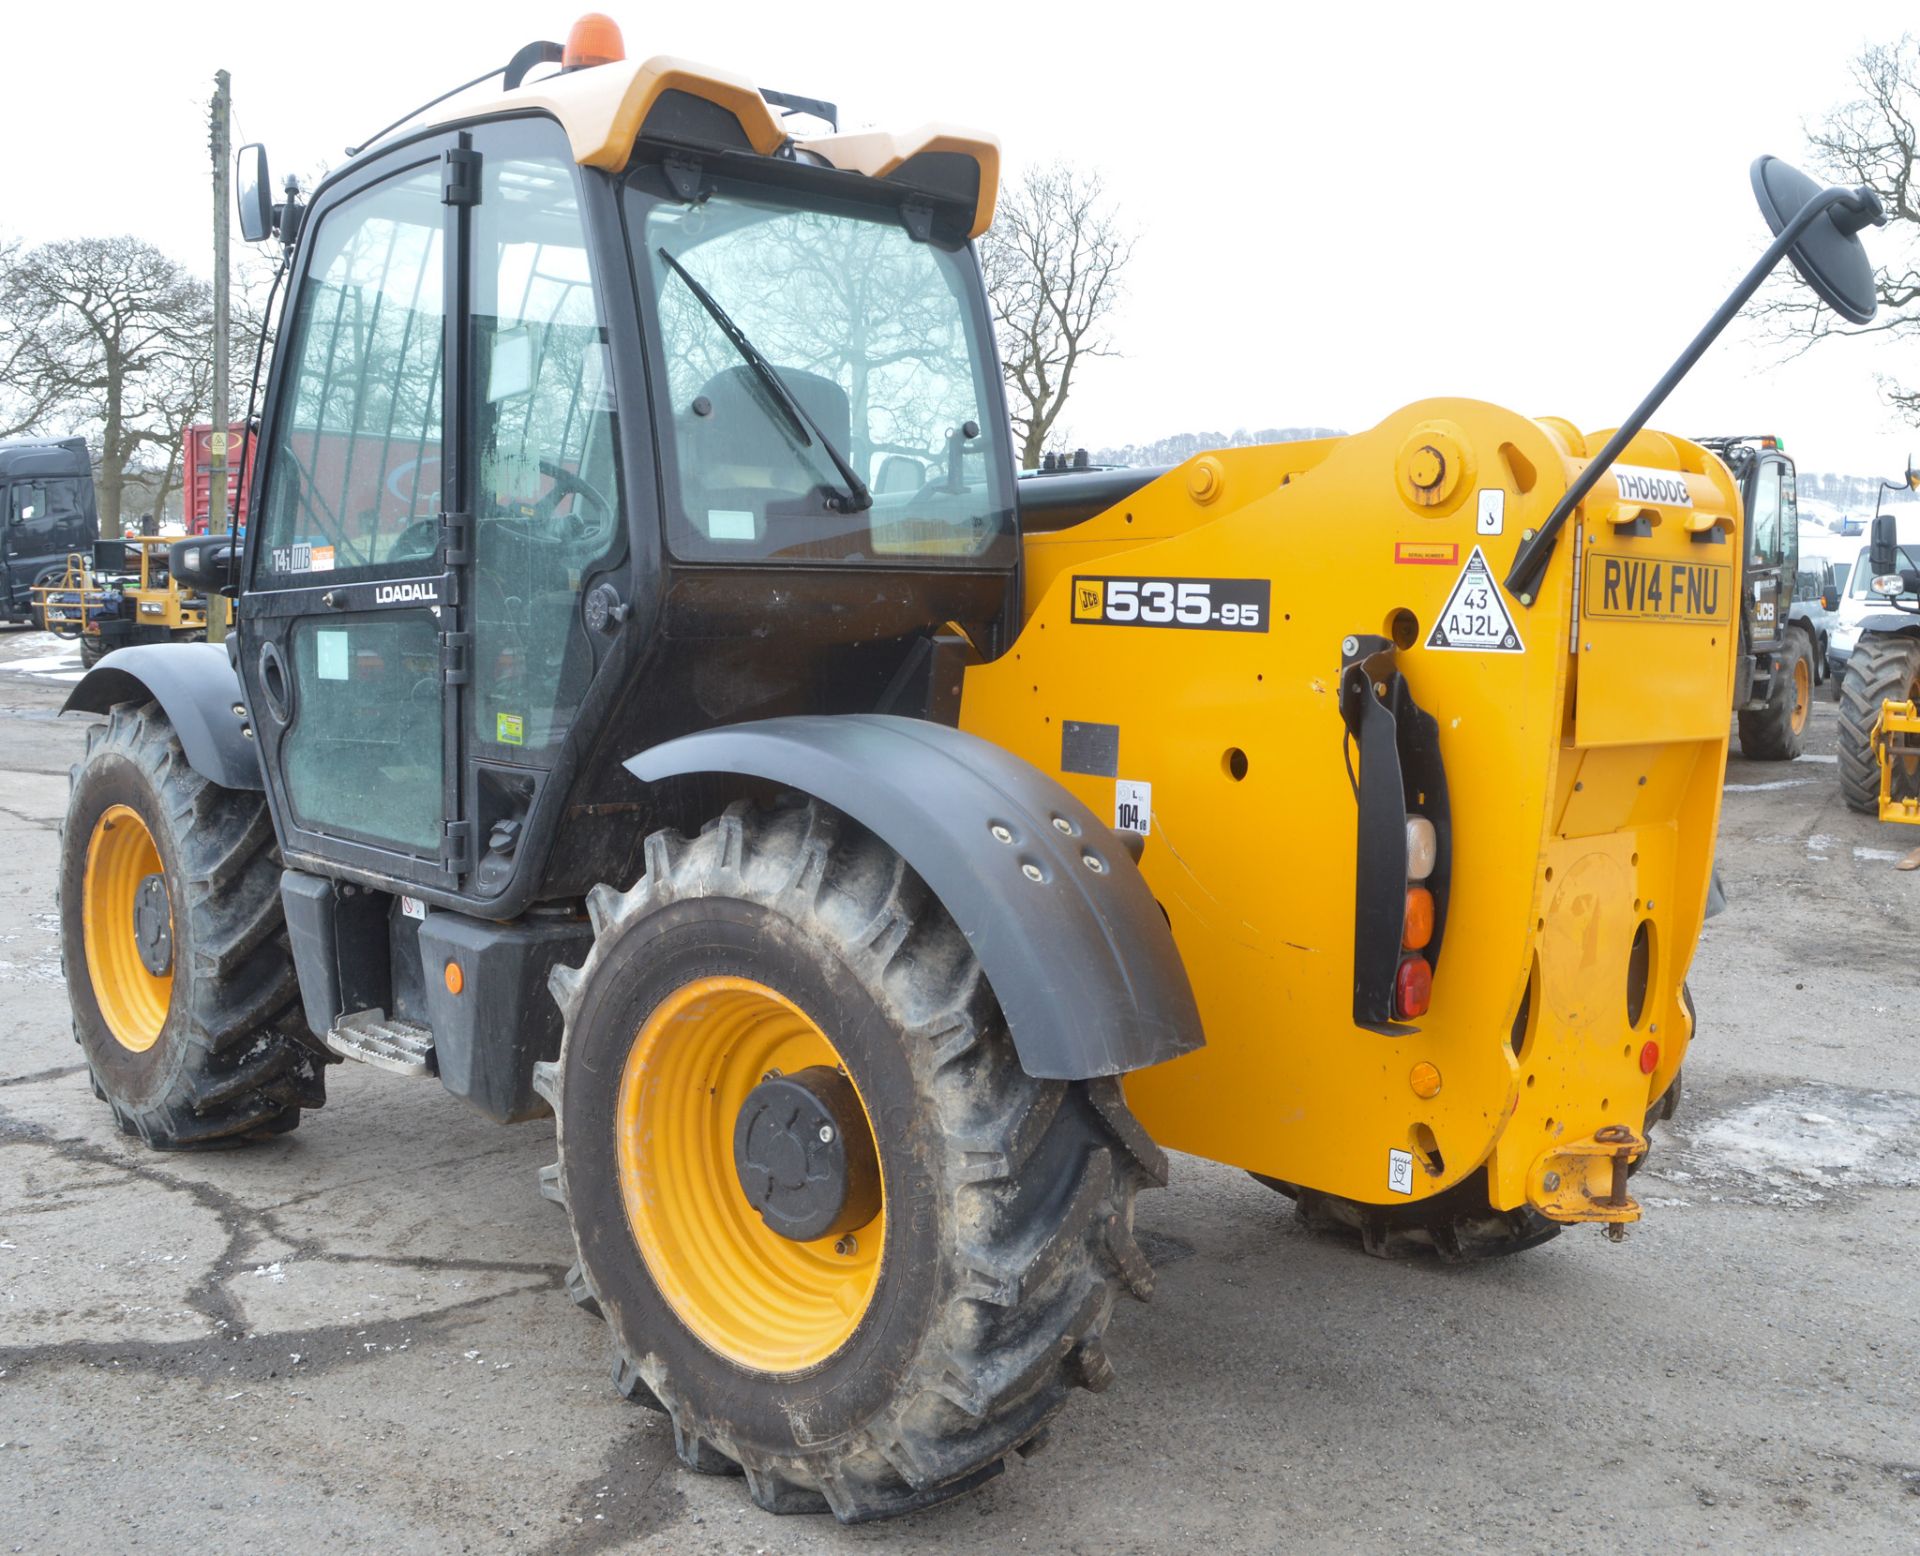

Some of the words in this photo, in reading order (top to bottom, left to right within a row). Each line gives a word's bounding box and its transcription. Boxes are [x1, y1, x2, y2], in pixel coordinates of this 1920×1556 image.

[376, 583, 438, 603] LOADALL
[1603, 559, 1662, 612] RV14
[1670, 565, 1718, 615] FNU
[1082, 590, 1098, 608] JCB
[1106, 581, 1259, 626] 535-95
[1464, 589, 1488, 609] 43
[1757, 603, 1774, 621] JCB
[1449, 615, 1499, 636] AJ2L
[1118, 803, 1138, 829] 104
